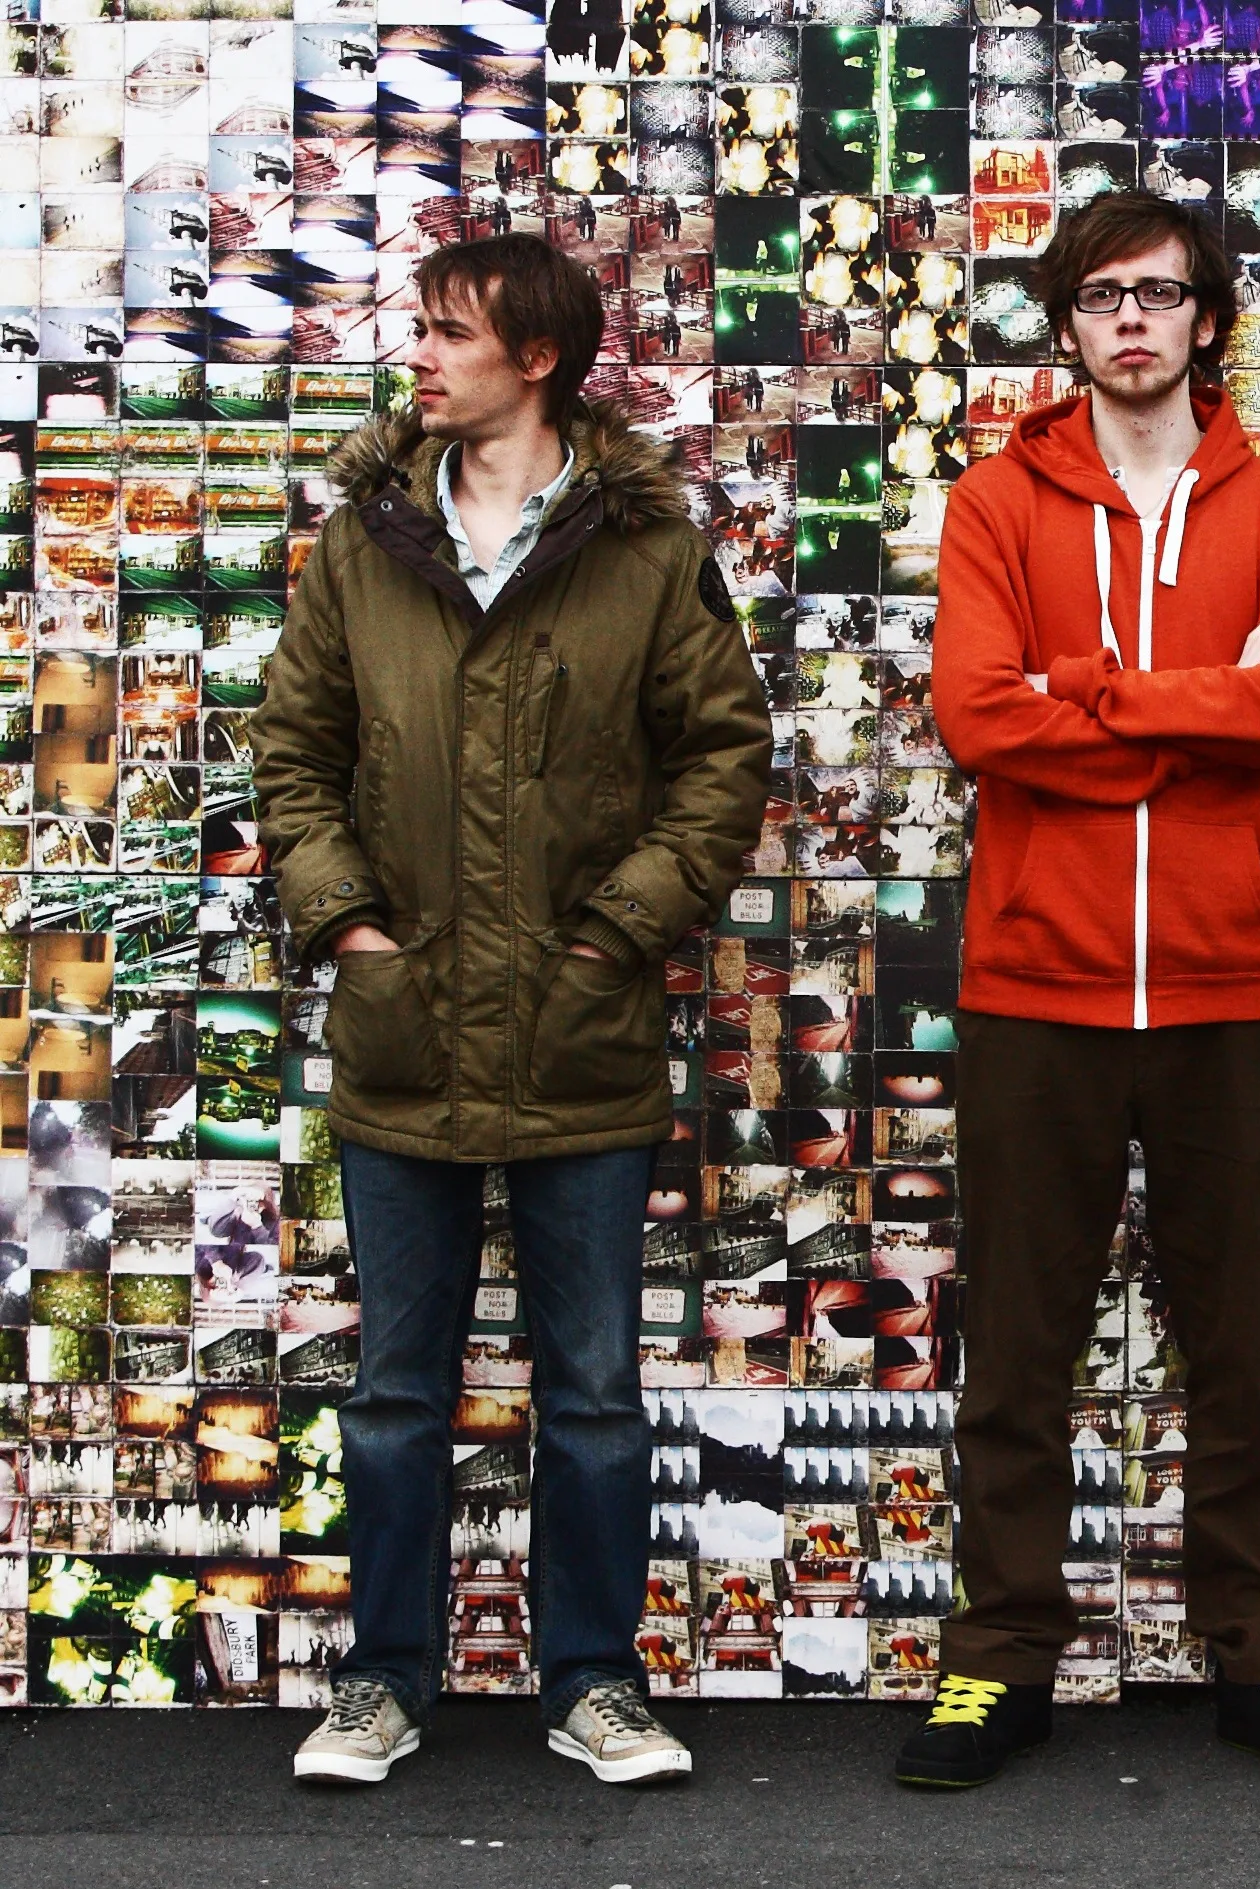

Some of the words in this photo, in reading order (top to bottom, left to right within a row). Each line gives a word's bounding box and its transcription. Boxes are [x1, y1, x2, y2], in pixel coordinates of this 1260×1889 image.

[739, 892, 763, 900] POST
[483, 1291, 506, 1299] POST
[651, 1292, 674, 1300] POST
[225, 1619, 244, 1677] DIDSBURY
[244, 1634, 256, 1664] PARK
